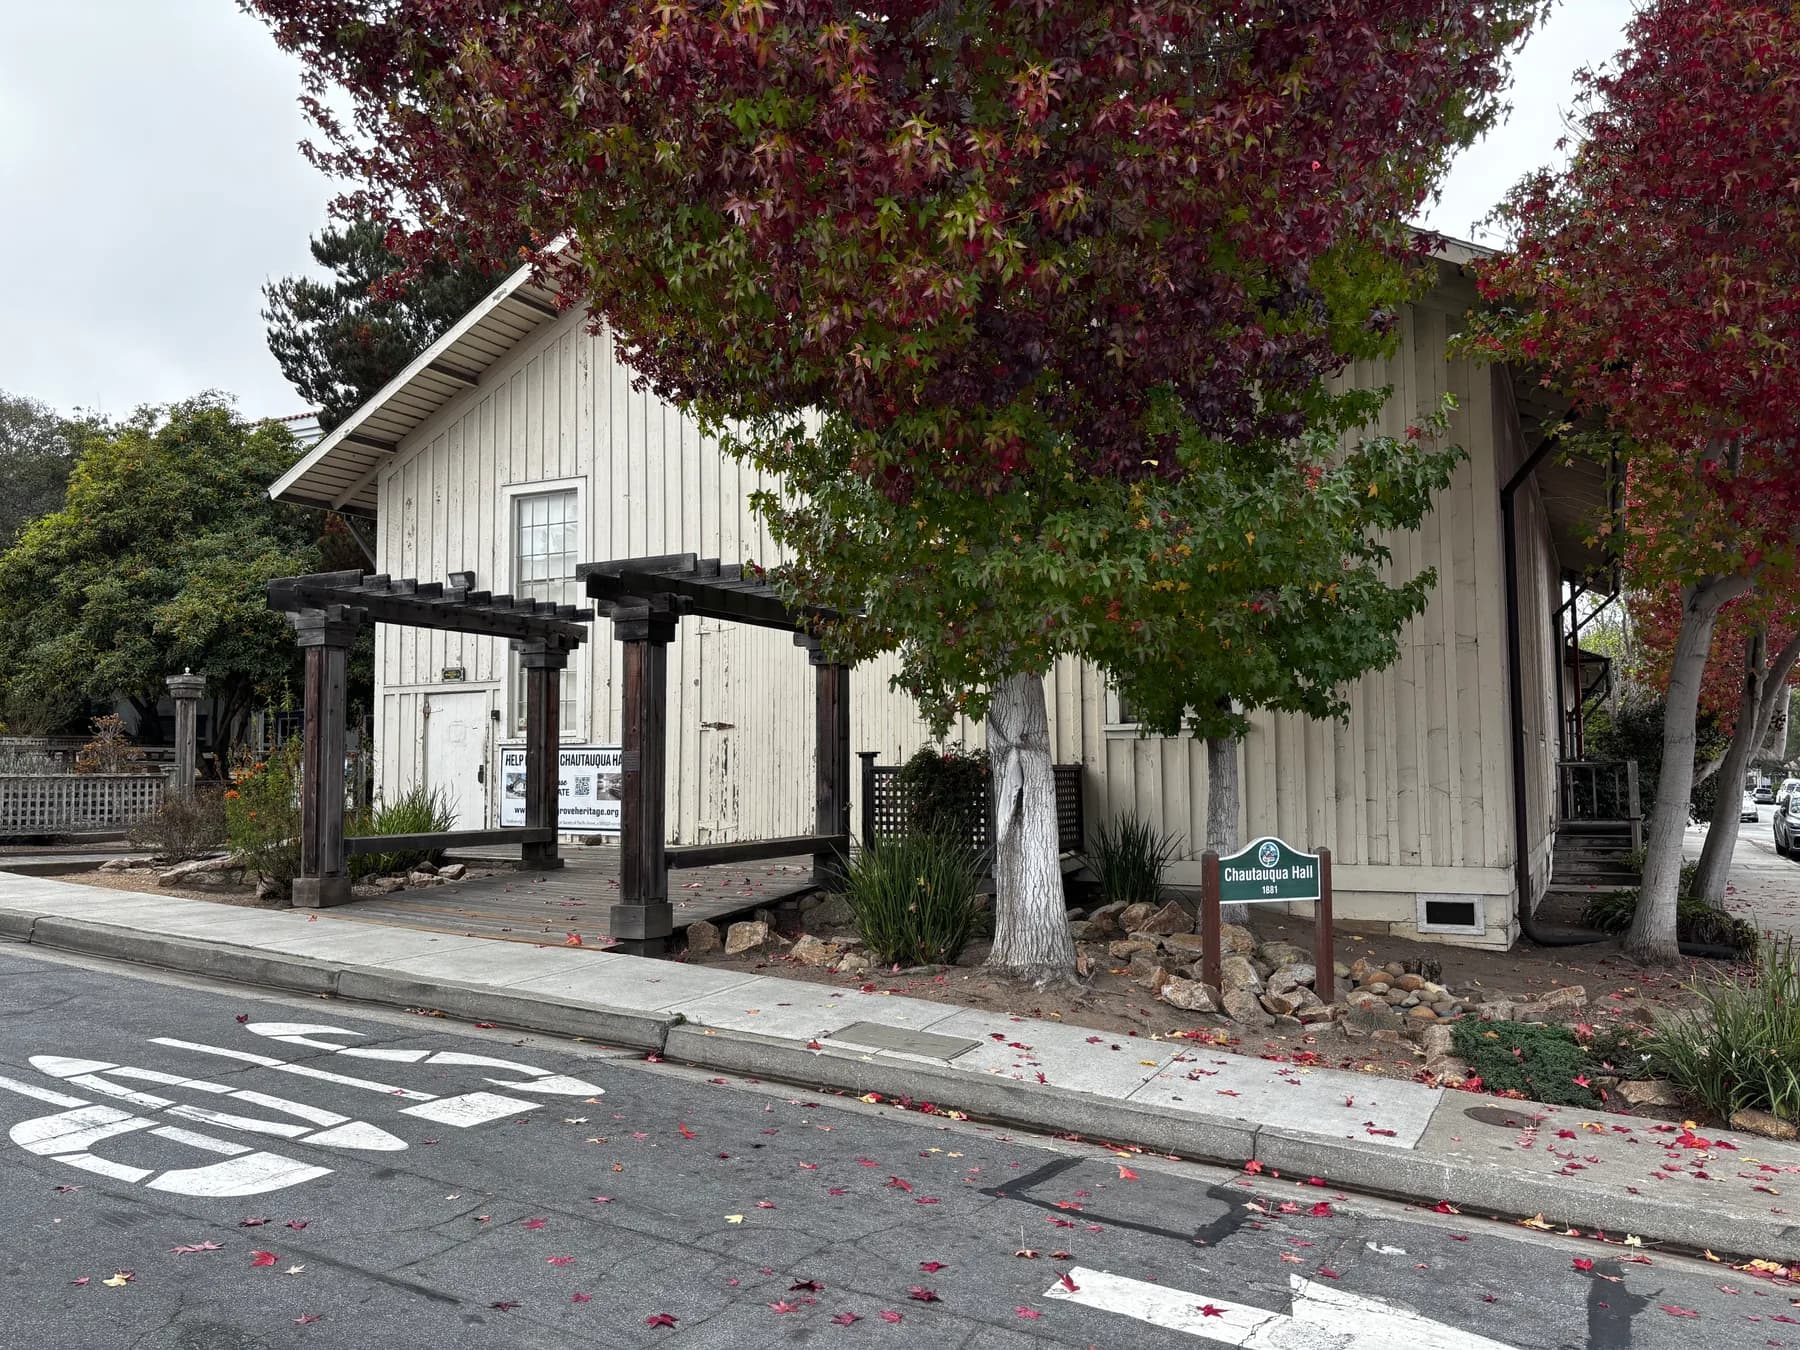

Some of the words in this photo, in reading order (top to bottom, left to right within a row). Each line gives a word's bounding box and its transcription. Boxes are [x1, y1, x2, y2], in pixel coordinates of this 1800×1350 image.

[505, 754, 524, 767] HELP
[559, 753, 611, 768] CHAUTAUQUA
[612, 754, 622, 767] HA
[1224, 867, 1289, 883] Chautauqua
[1292, 865, 1313, 879] Hall
[1262, 885, 1278, 894] 1881
[0, 1022, 606, 1197] STOP
